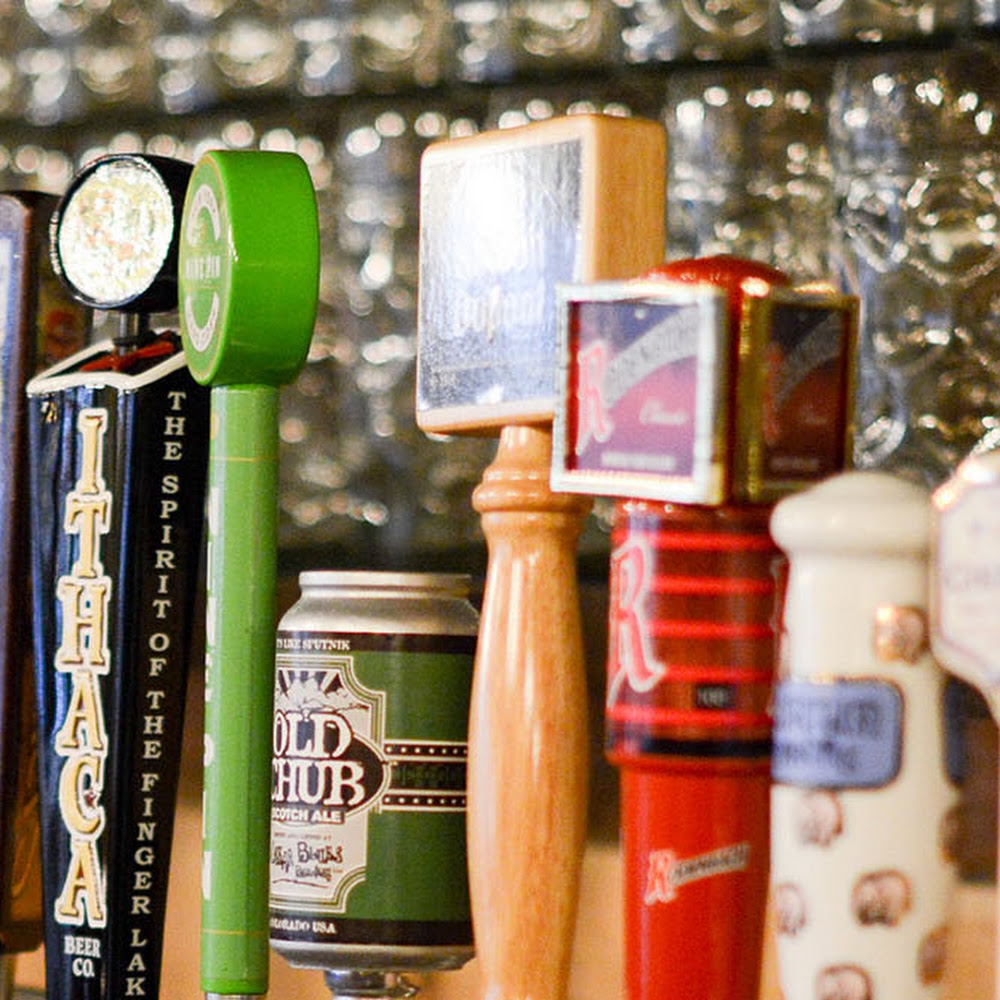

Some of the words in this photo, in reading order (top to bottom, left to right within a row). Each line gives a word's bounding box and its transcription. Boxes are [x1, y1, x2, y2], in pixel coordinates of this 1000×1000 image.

[164, 391, 187, 461] THE
[153, 475, 179, 618] SPIRIT
[55, 408, 112, 929] ITHACA
[149, 633, 170, 676] OF
[302, 639, 351, 651] SPUTNIK
[143, 691, 165, 759] THE
[273, 711, 352, 759] OLD
[272, 759, 365, 806] HUB
[310, 809, 342, 823] ALE
[130, 774, 160, 914] FINGER
[64, 935, 101, 958] BEER
[72, 958, 95, 978] CO.
